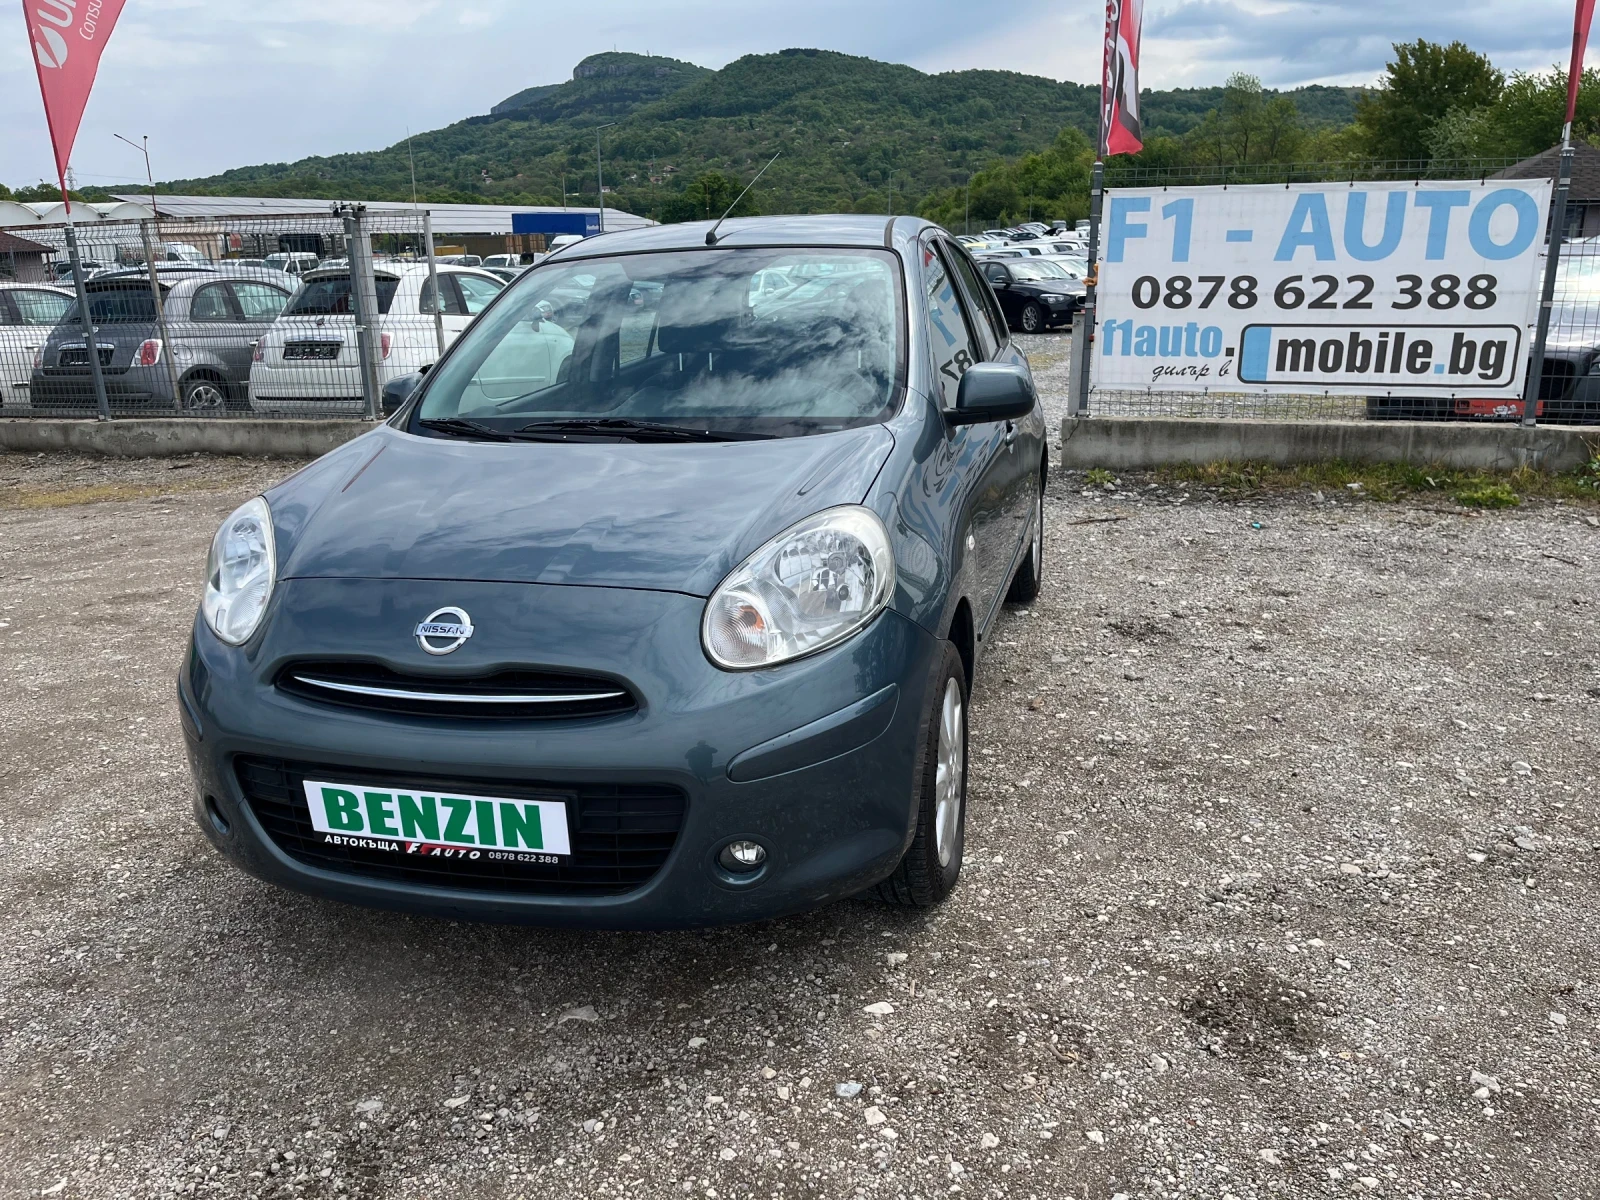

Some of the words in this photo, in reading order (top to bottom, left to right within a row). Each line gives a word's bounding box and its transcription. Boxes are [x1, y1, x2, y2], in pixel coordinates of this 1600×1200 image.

[1107, 197, 1194, 262] F1
[1273, 188, 1539, 262] AUTO
[1131, 275, 1258, 310] 0878
[1274, 275, 1375, 310] 622
[1391, 274, 1498, 310] 388
[1152, 363, 1210, 382] дилър
[1219, 359, 1233, 377] в
[1275, 331, 1508, 381] mobile.bg
[420, 625, 465, 635] NISSAN
[321, 787, 544, 850] BENZIN
[324, 834, 399, 852] АВТОКЪЩА
[430, 847, 481, 859] AUTO
[488, 851, 515, 861] 0878
[517, 853, 537, 862] 622
[538, 855, 559, 864] 388
